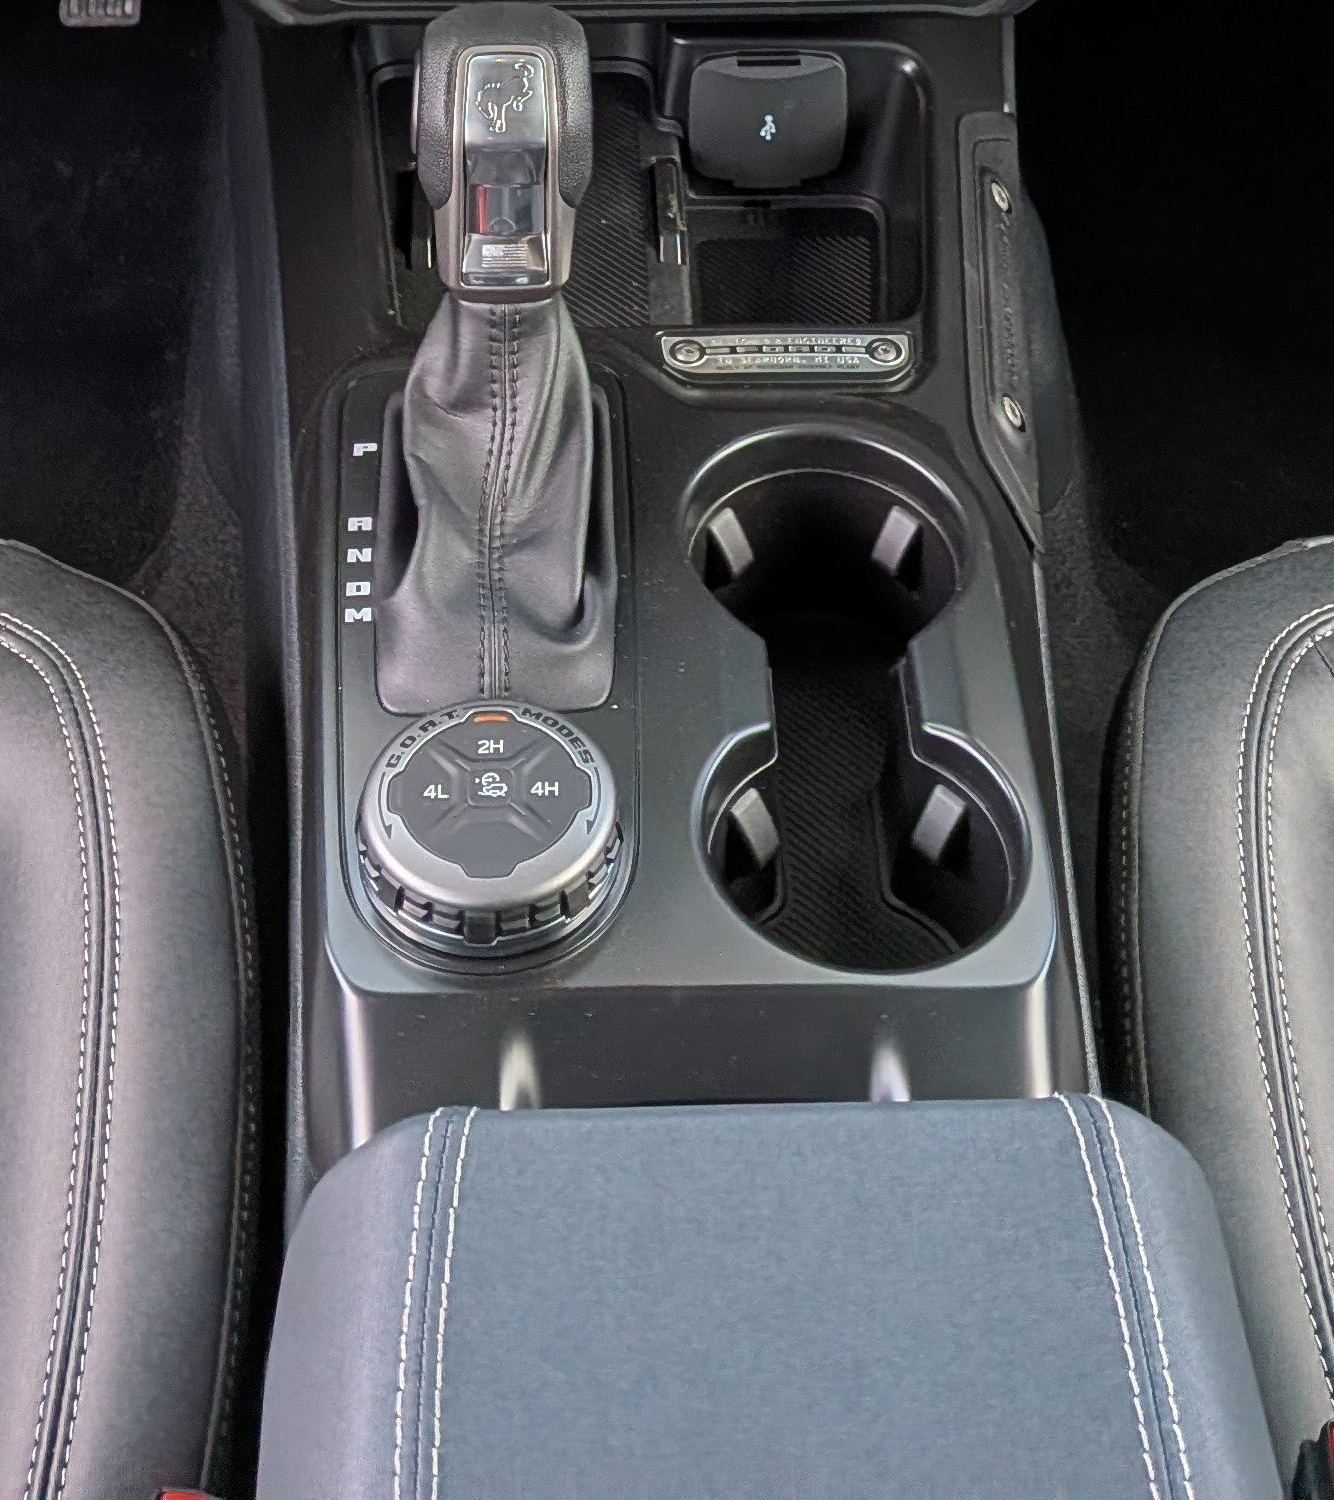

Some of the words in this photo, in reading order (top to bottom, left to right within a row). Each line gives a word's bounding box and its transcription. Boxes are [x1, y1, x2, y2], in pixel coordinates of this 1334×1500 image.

[353, 442, 378, 458] P
[348, 517, 373, 532] R
[347, 548, 372, 563] N
[346, 581, 371, 596] D
[344, 607, 373, 623] M
[521, 708, 596, 764] MODES
[478, 740, 504, 754] 2H
[423, 785, 449, 798] 4L
[531, 782, 559, 796] 4H
